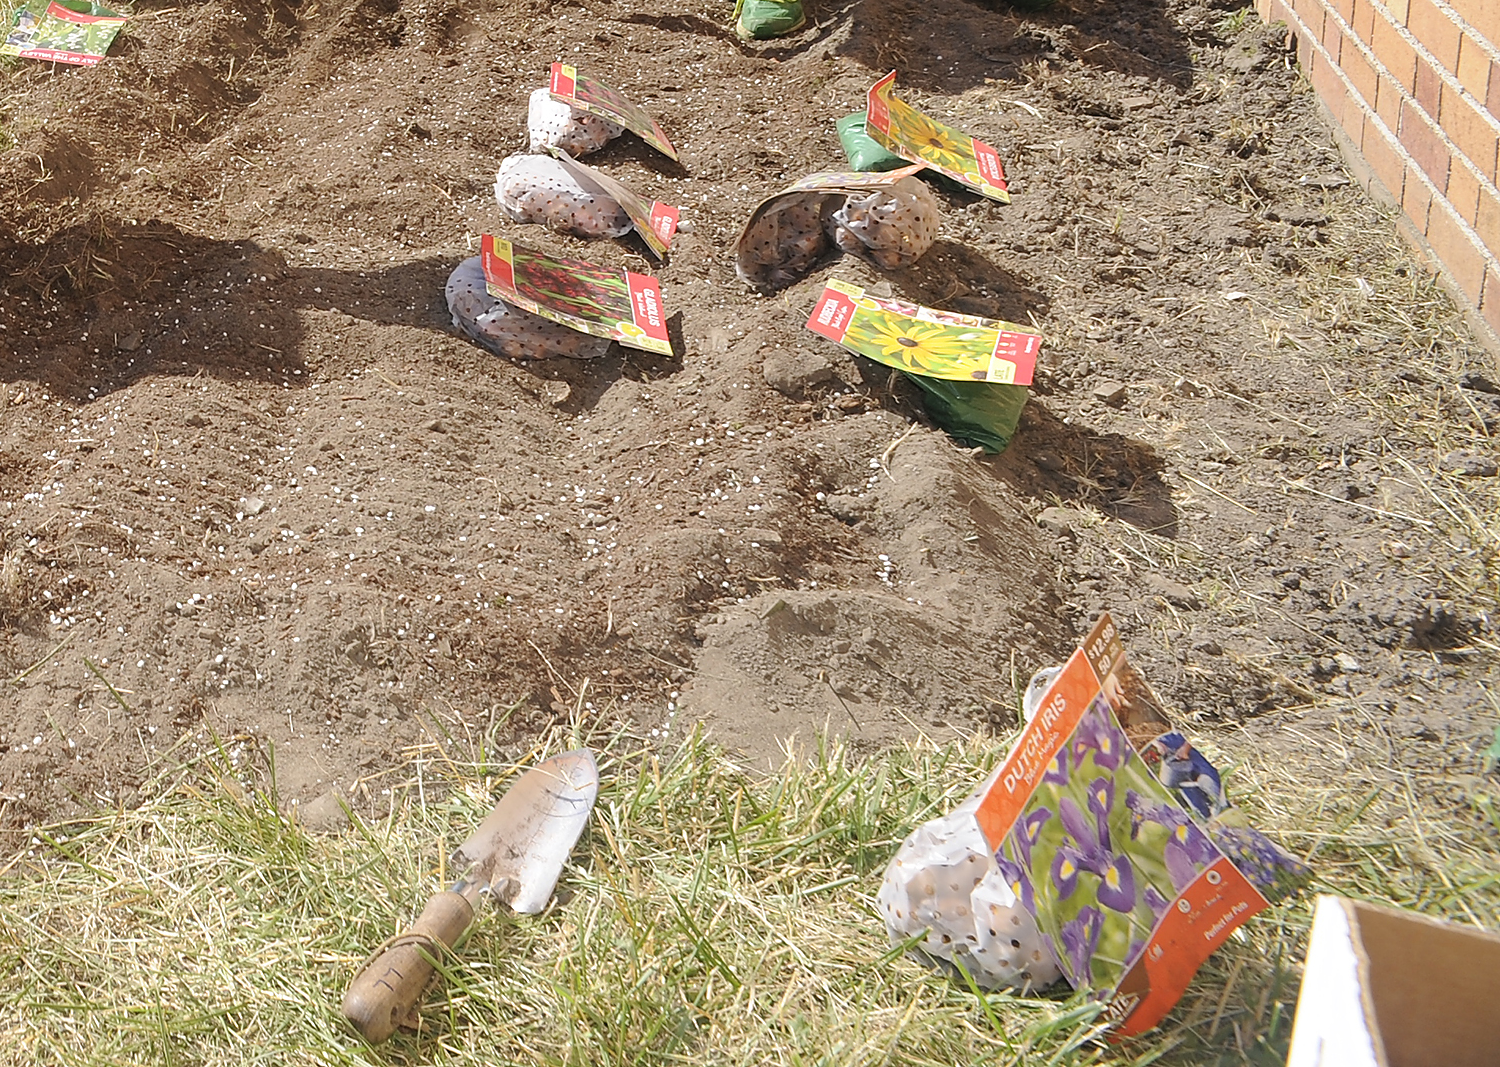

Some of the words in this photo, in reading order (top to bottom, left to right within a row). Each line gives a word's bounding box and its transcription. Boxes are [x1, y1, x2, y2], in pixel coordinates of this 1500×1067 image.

[643, 288, 660, 327] GLADIOLUS
[1088, 623, 1115, 660] $12.98
[1003, 726, 1044, 795] DUTCH
[1040, 693, 1068, 732] IRIS
[1024, 760, 1040, 786] Blue
[1203, 917, 1227, 941] Perfect
[1224, 912, 1235, 924] for
[1232, 900, 1249, 916] Pots
